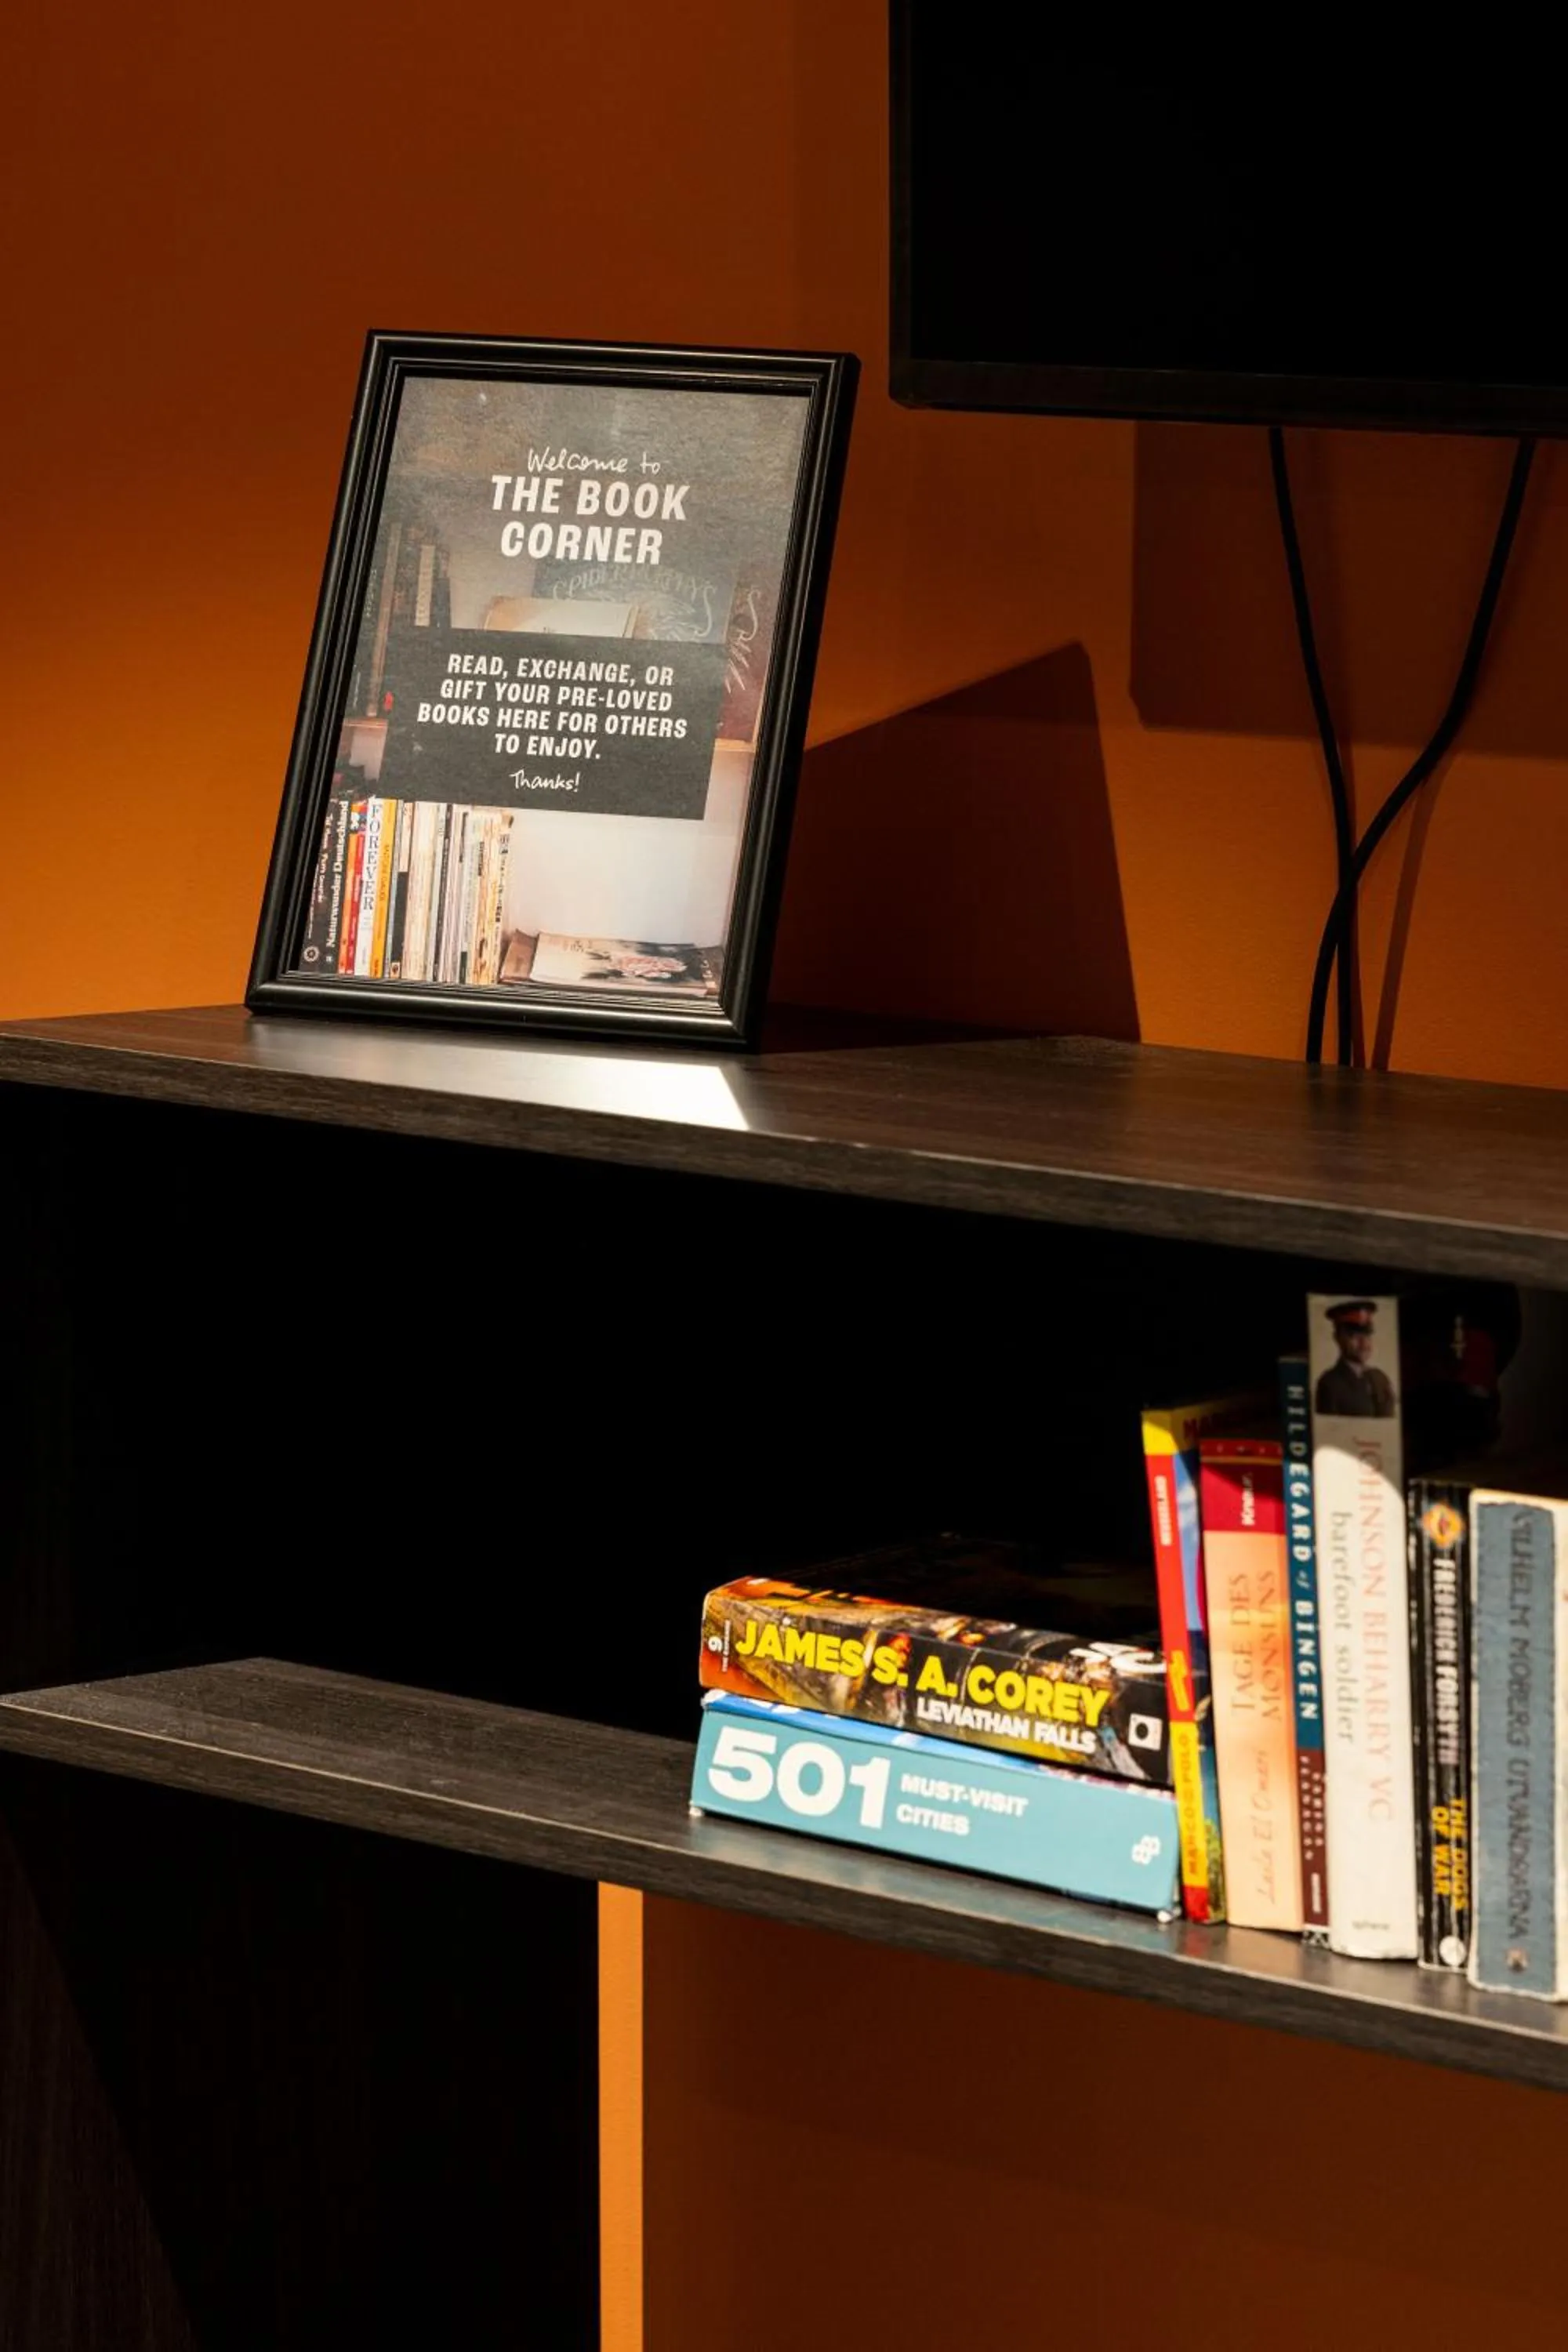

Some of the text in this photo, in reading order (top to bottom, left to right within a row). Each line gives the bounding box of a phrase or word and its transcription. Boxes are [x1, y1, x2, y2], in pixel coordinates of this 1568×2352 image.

[527, 447, 661, 475] Welcome to
[491, 475, 691, 521] THE BOOK
[500, 521, 663, 565] CORNER
[440, 679, 673, 712] GIFT YOUR PRE-LOVED
[447, 654, 674, 686] READ, EXCHANGE, OR
[417, 702, 688, 739] BOOKS HERE FOR OTHERS
[494, 733, 601, 760] TO ENJOY.
[510, 768, 580, 792] Thanks!
[332, 800, 349, 872] Deutschland
[362, 803, 383, 911] FOREVER
[1287, 1385, 1312, 1563] HILDEGARD
[708, 1636, 722, 1652] 9
[1228, 1573, 1257, 1717] TAGE DES
[1256, 1570, 1282, 1722] MONSUNS
[1295, 1600, 1319, 1720] BINGEN
[1330, 1510, 1359, 1744] barefoot soldier
[1353, 1439, 1393, 1821] JOHNSON BEHARRY VC
[1432, 1558, 1460, 1766] FREDERICK FORSYTH
[735, 1619, 865, 1678] JAMES
[872, 1647, 909, 1688] S.
[916, 1655, 957, 1699] A.
[965, 1664, 1112, 1726] COREY
[1507, 1636, 1532, 1748] MOBERG
[916, 1697, 1097, 1755] LEVIATHAN FALLS
[1178, 1732, 1193, 1784] POLO
[707, 1726, 891, 1830] 501
[901, 1773, 1029, 1818] MUST-VISIT
[896, 1803, 971, 1837] CITIES
[1431, 1805, 1452, 1896] OF WAR
[1449, 1796, 1468, 1911] THE DOGS
